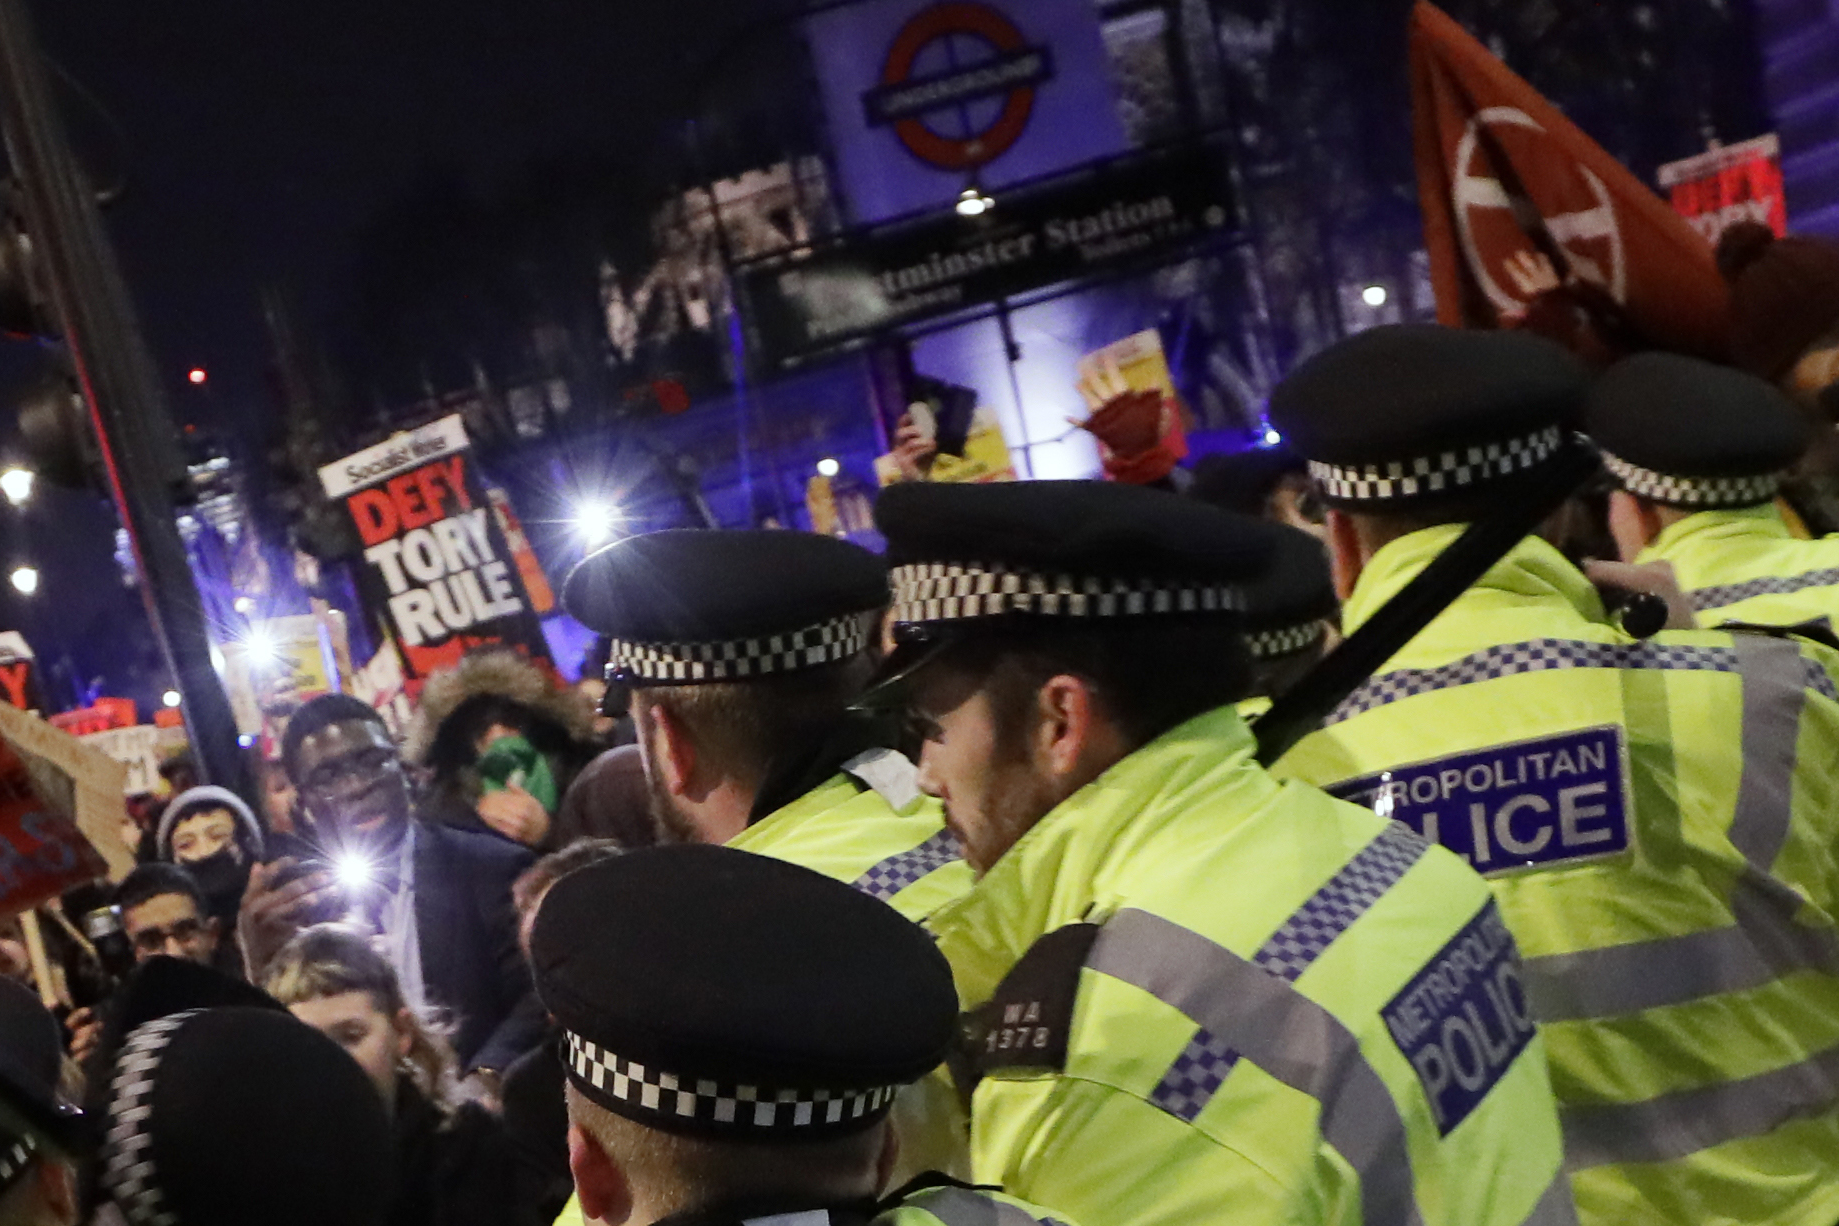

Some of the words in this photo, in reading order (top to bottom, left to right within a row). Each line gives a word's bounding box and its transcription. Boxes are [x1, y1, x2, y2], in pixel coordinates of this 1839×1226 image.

[1043, 195, 1175, 249] Station
[348, 455, 472, 546] DEFY
[364, 507, 496, 595] TORY
[388, 561, 523, 646] RULE
[986, 1026, 1050, 1052] 1378
[1414, 960, 1531, 1126] POLIC
